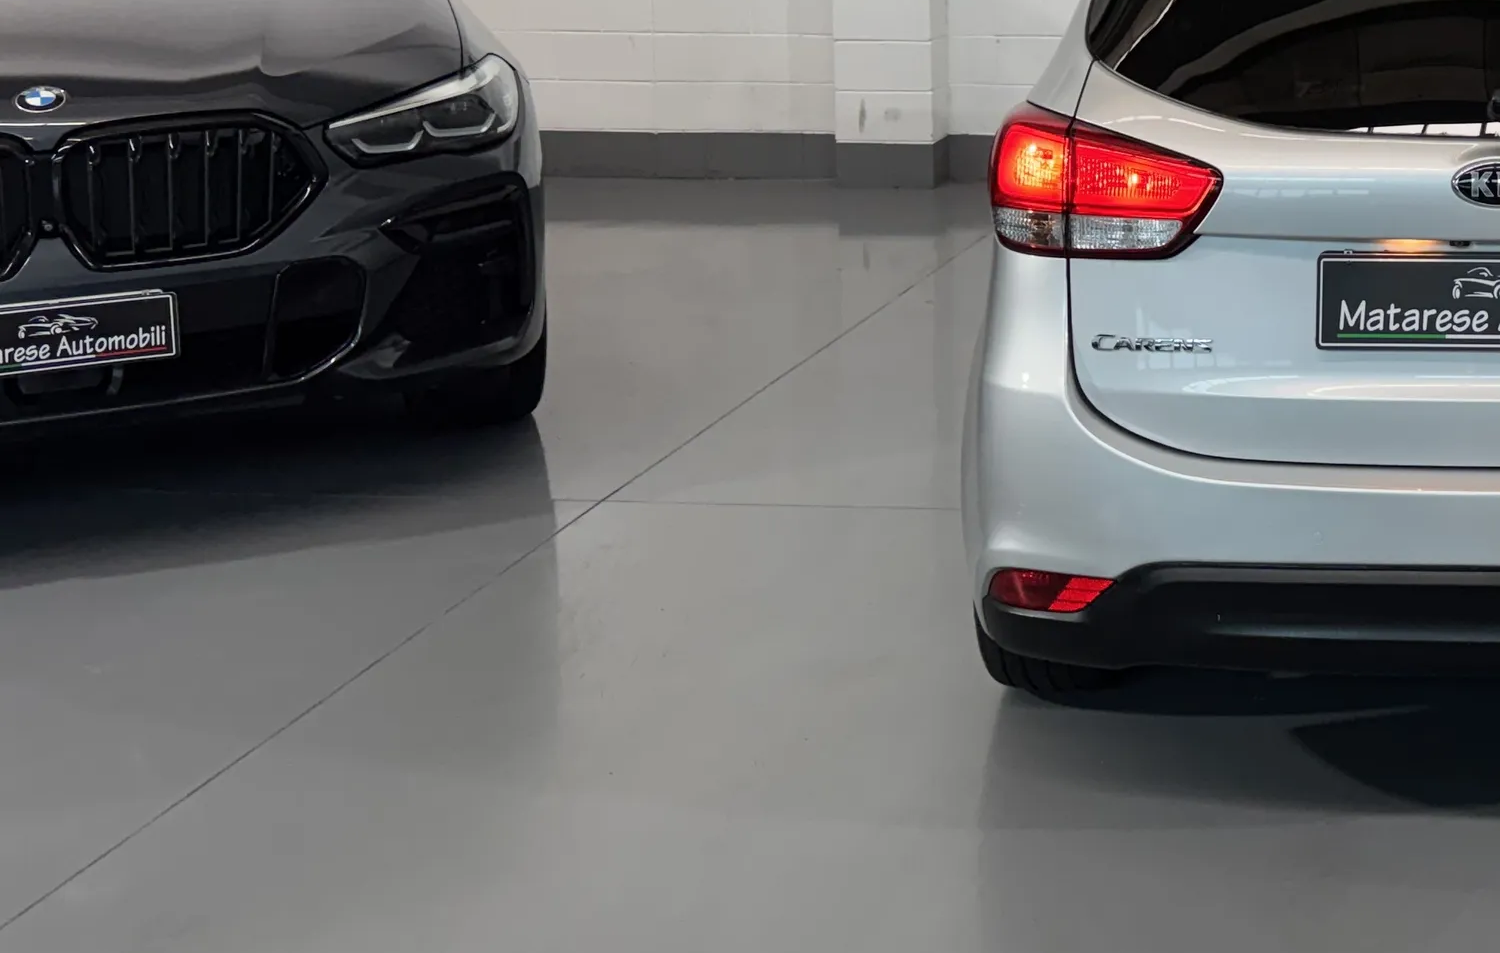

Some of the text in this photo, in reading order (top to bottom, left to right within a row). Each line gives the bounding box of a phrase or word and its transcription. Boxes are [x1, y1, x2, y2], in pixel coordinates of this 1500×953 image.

[1339, 299, 1489, 333] Matarese
[0, 324, 167, 365] rese Automobili
